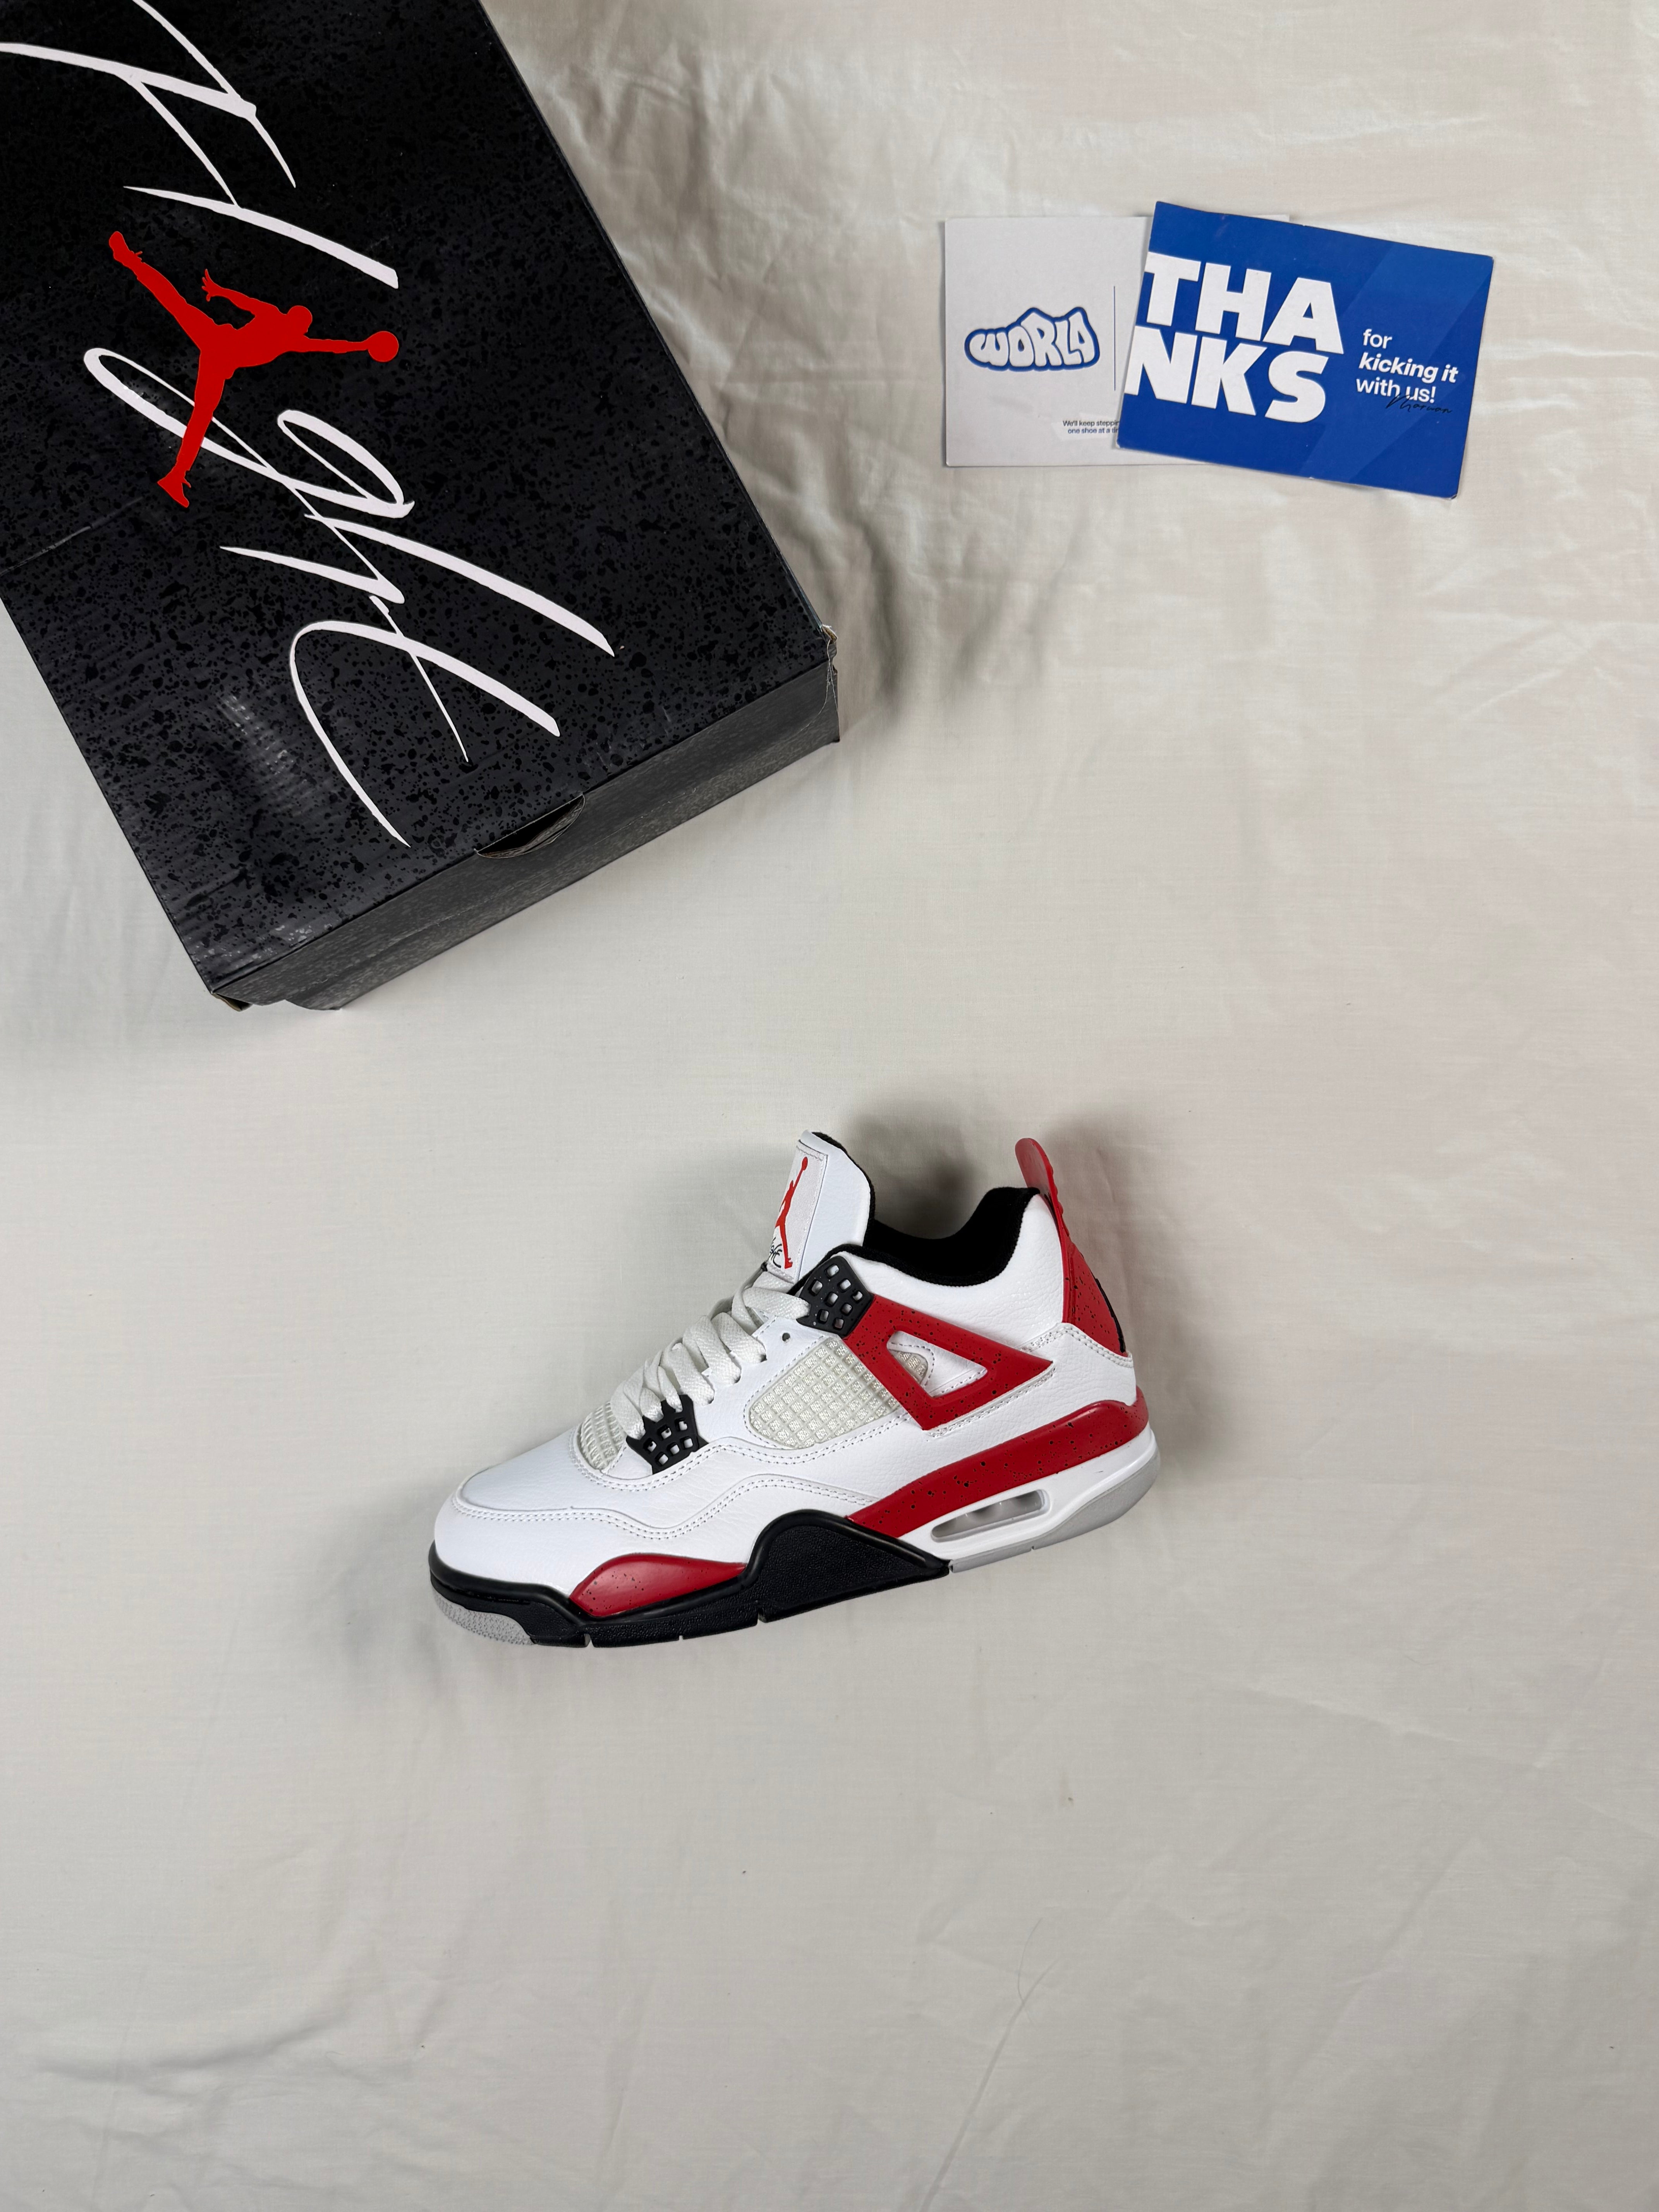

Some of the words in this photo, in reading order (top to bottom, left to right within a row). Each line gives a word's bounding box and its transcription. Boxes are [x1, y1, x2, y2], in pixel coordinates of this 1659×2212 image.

[1144, 251, 1344, 354] THA
[1358, 352, 1439, 383] kicking
[1441, 364, 1458, 383] it
[1363, 329, 1393, 349] for
[1124, 325, 1329, 423] NKS
[1356, 377, 1400, 397] with
[1405, 386, 1436, 403] us!
[0, 0, 615, 847] Flght
